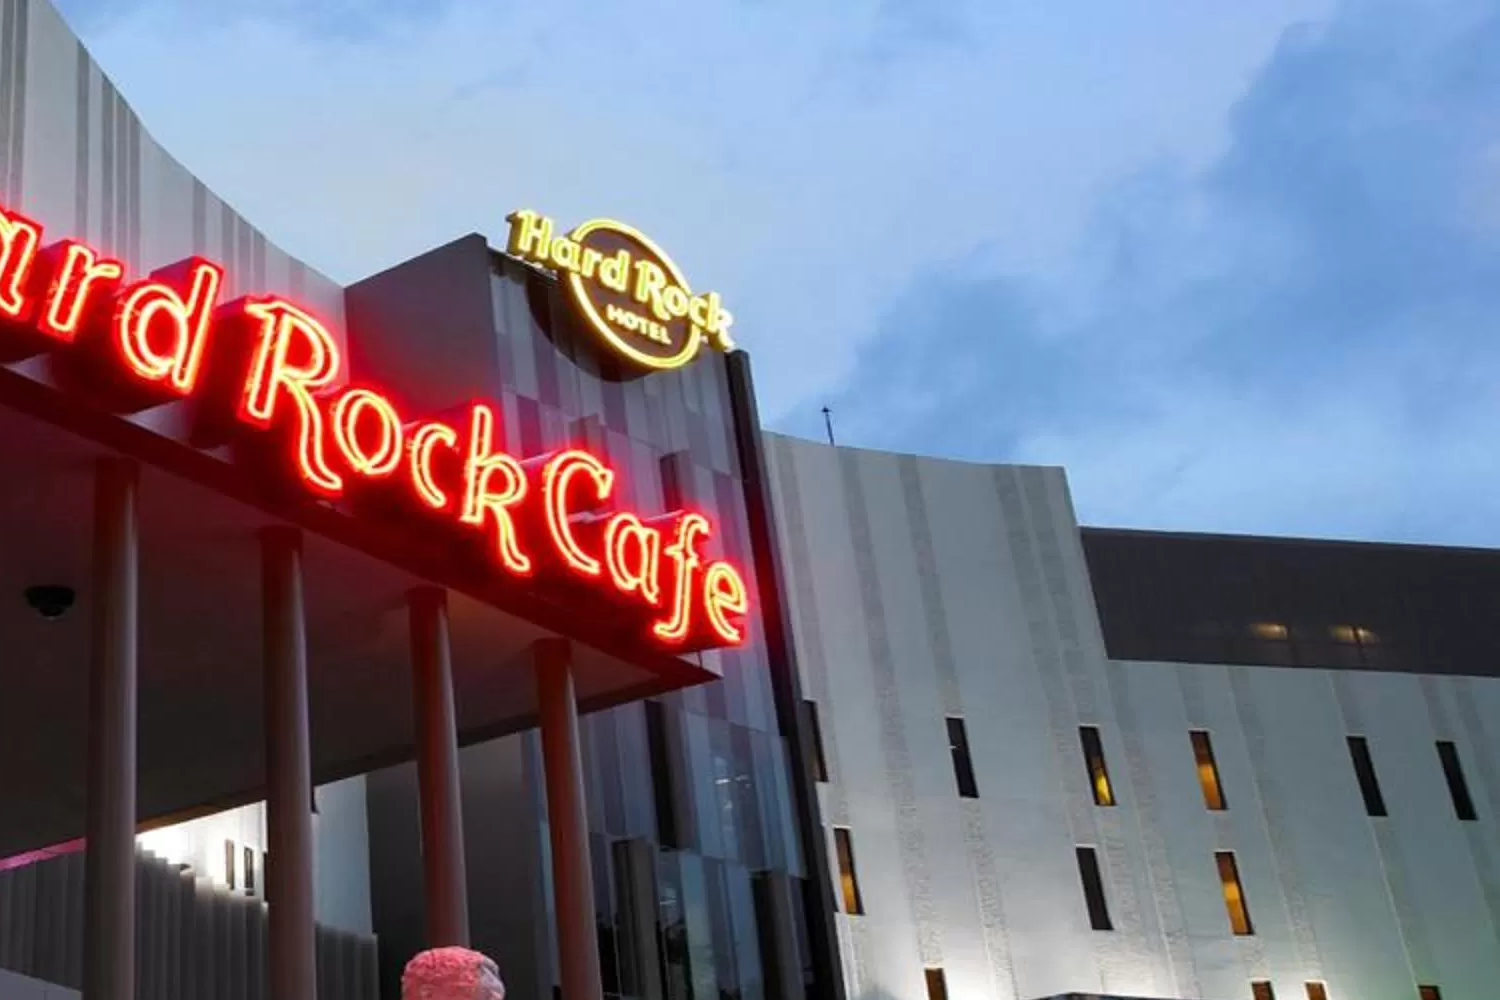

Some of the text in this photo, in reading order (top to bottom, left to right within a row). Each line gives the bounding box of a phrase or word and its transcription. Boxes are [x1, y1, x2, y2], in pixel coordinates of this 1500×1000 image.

[510, 209, 735, 350] Hard Rock
[605, 303, 672, 345] HOTEL
[238, 295, 532, 576] Rock
[542, 446, 750, 643] Cafe
